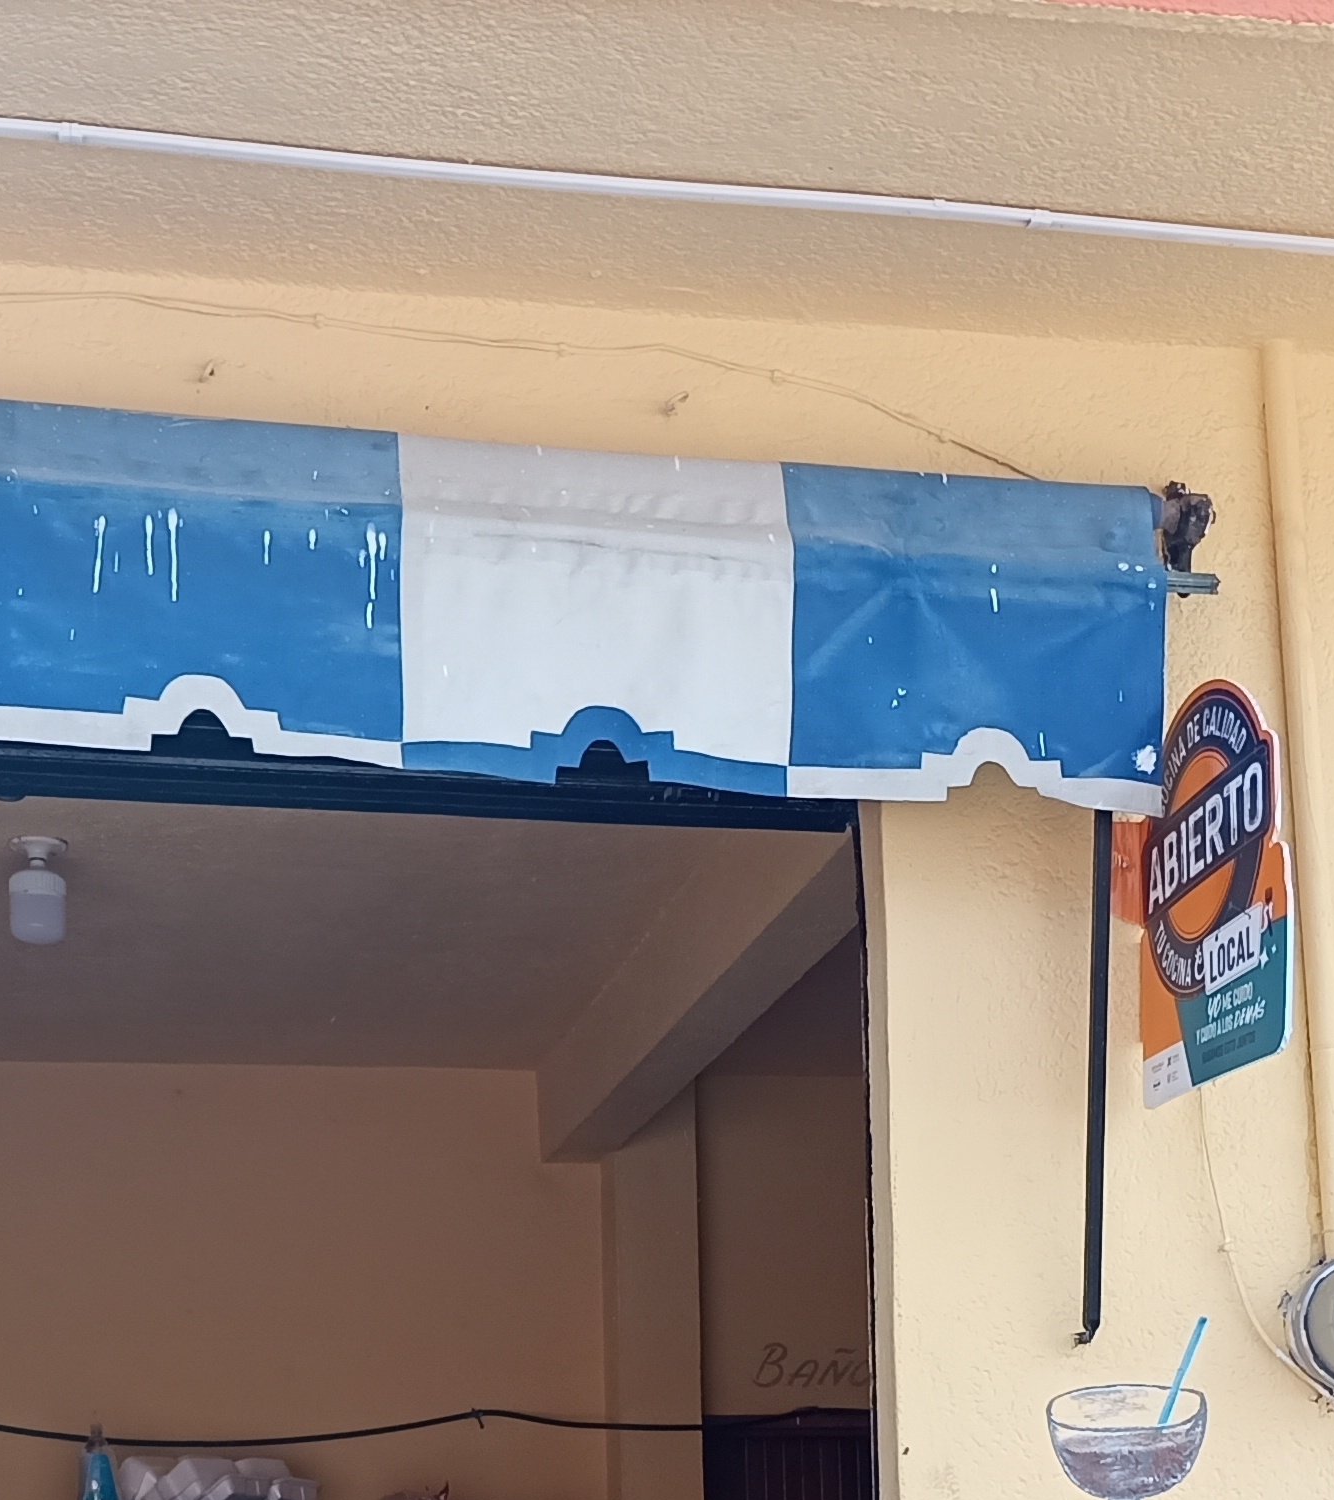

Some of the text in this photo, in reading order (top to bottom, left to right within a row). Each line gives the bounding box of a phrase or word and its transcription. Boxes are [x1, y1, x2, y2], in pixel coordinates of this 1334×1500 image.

[1187, 713, 1200, 749] DE
[1203, 705, 1247, 754] CALIDAD
[1147, 760, 1264, 916] ABIERTO
[1154, 920, 1192, 987] TU COCINA
[1209, 926, 1255, 985] LOCAL
[1207, 993, 1222, 1023] YO
